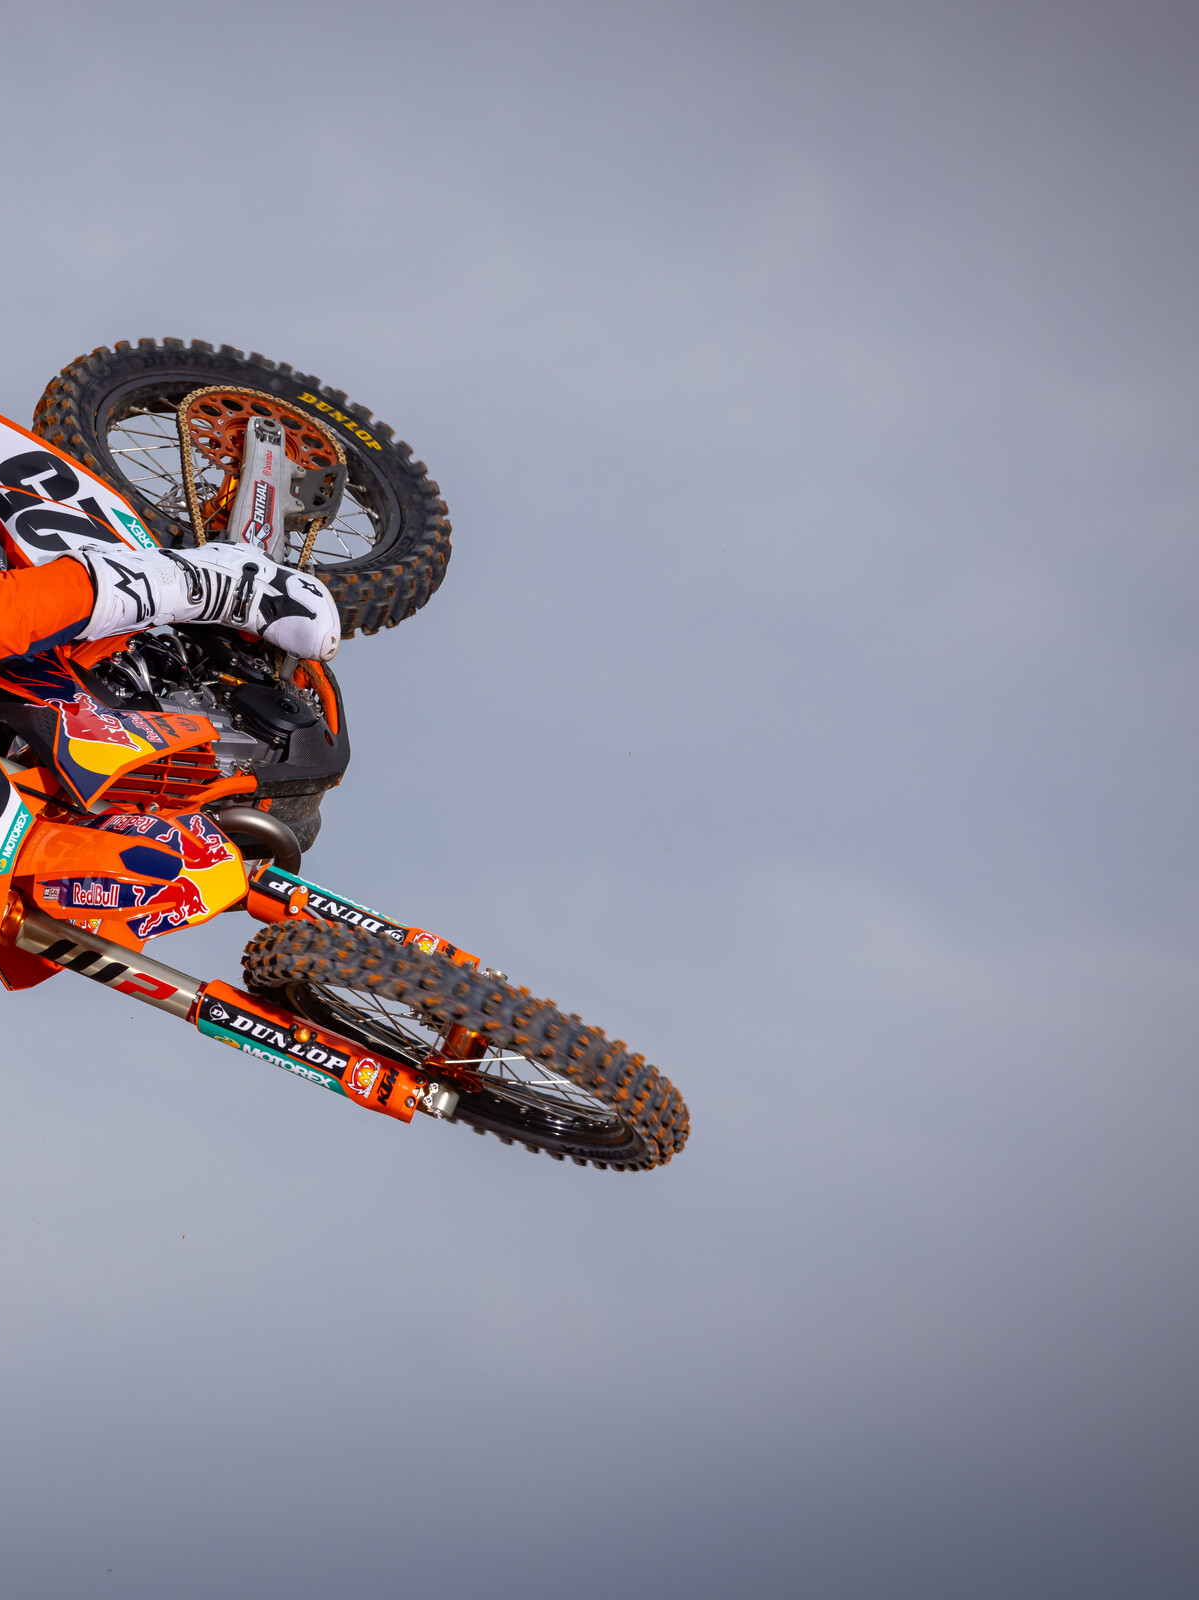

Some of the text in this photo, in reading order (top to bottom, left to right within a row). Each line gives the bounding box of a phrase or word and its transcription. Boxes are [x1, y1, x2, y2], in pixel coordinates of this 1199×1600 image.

[296, 392, 383, 450] DUNLOP
[3, 811, 29, 858] MOTOREX
[121, 816, 158, 834] Red
[73, 883, 95, 907] Red
[93, 884, 120, 907] Bull
[230, 1014, 348, 1070] DUNLOP
[242, 1045, 333, 1090] MOTOREX
[377, 1067, 400, 1106] KTM
